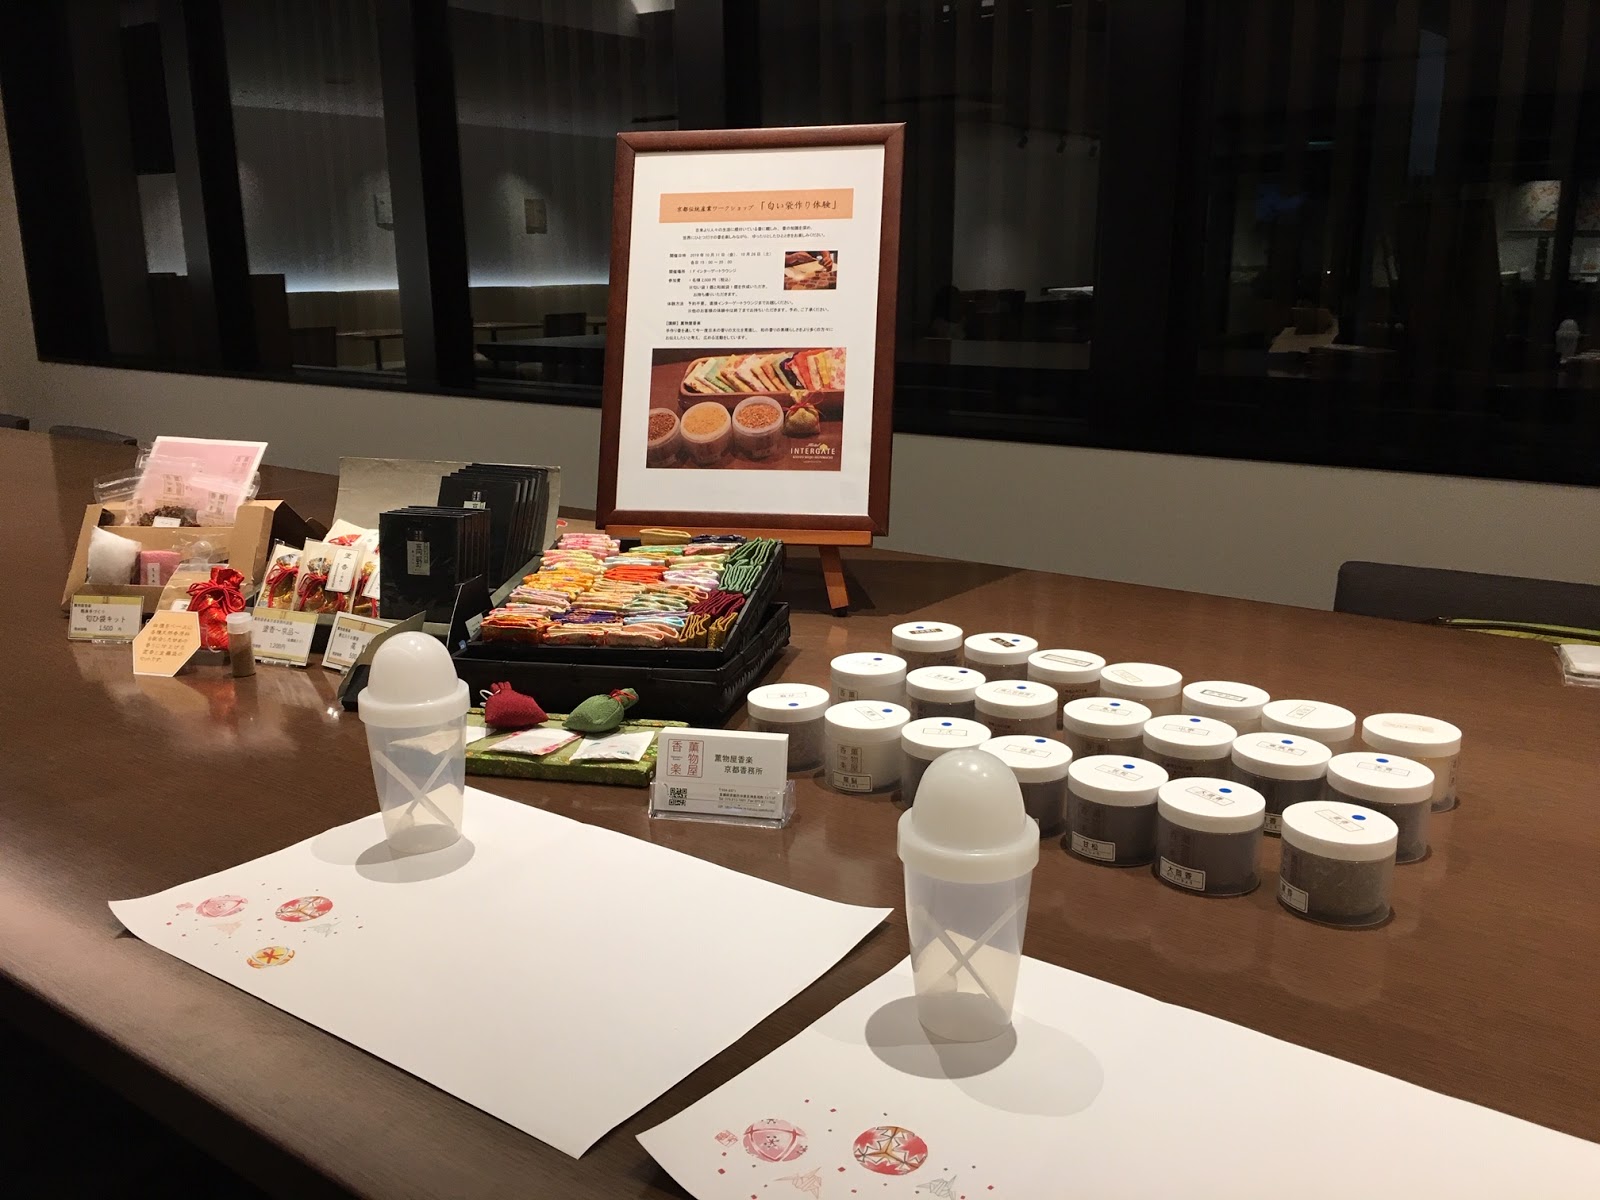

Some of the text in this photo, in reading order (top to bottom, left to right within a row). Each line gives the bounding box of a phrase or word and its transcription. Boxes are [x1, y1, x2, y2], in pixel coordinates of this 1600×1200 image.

[676, 199, 837, 213] 京都伝統産業ワークショップ 「匂い袋作り体験」
[790, 447, 836, 455] INTERGATE
[687, 741, 699, 776] 薫物屋
[714, 754, 754, 765] 薫物屋香楽
[724, 765, 763, 776] 京都香務所
[1082, 840, 1099, 851] 甘松
